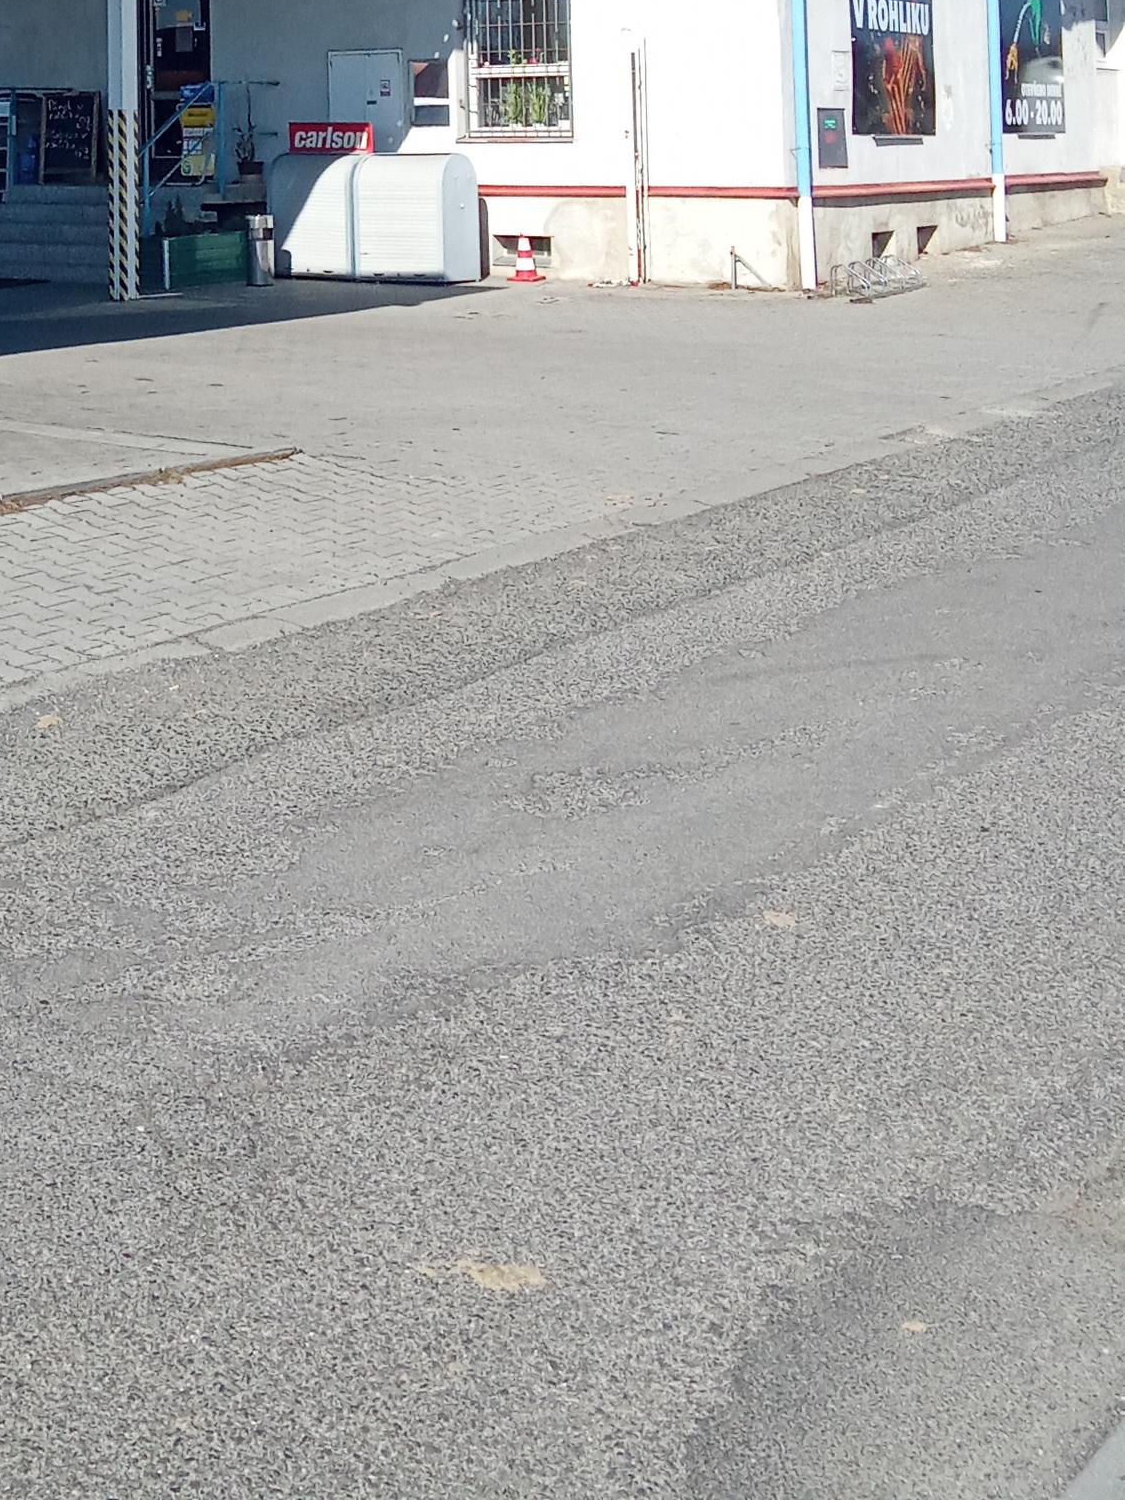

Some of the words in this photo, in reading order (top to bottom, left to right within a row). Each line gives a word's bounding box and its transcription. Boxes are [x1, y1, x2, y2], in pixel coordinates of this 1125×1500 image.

[1005, 98, 1029, 126] 6.00
[1035, 99, 1063, 126] 20.00
[294, 125, 369, 149] carlson
